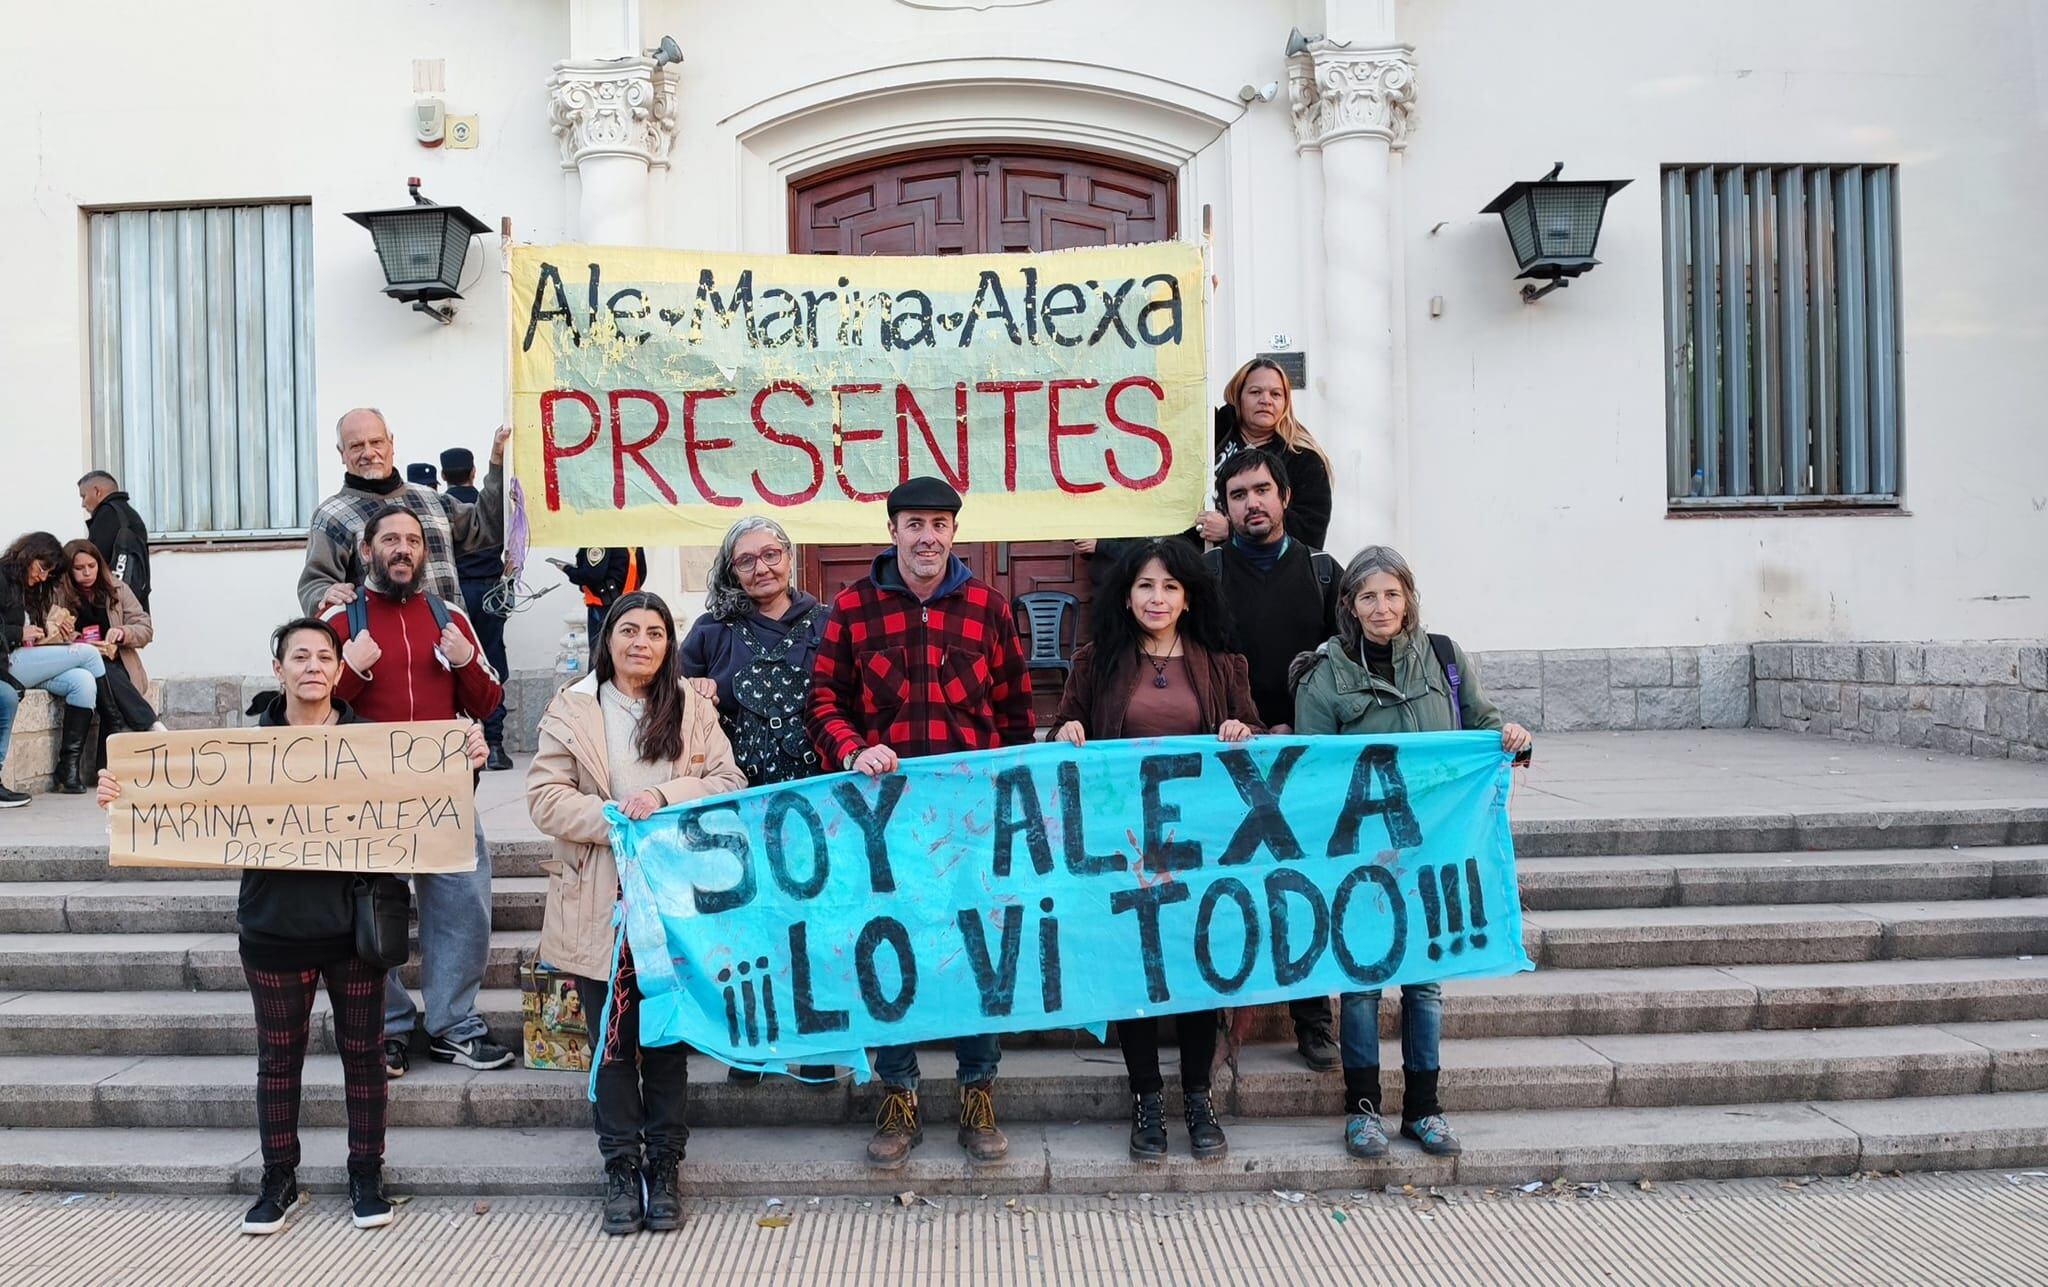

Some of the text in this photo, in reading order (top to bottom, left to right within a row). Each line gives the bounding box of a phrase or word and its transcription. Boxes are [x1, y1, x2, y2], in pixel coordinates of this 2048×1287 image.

[523, 262, 1183, 352] Ale Marina Alexa
[541, 376, 1174, 511] PRESENTES
[389, 729, 470, 775] POR
[223, 833, 418, 871] PRESENTES!
[280, 804, 341, 837] ALE
[357, 795, 462, 831] ALEXA
[679, 744, 1422, 914] SOY ALEXA
[1110, 857, 1488, 1004] TODO!!!
